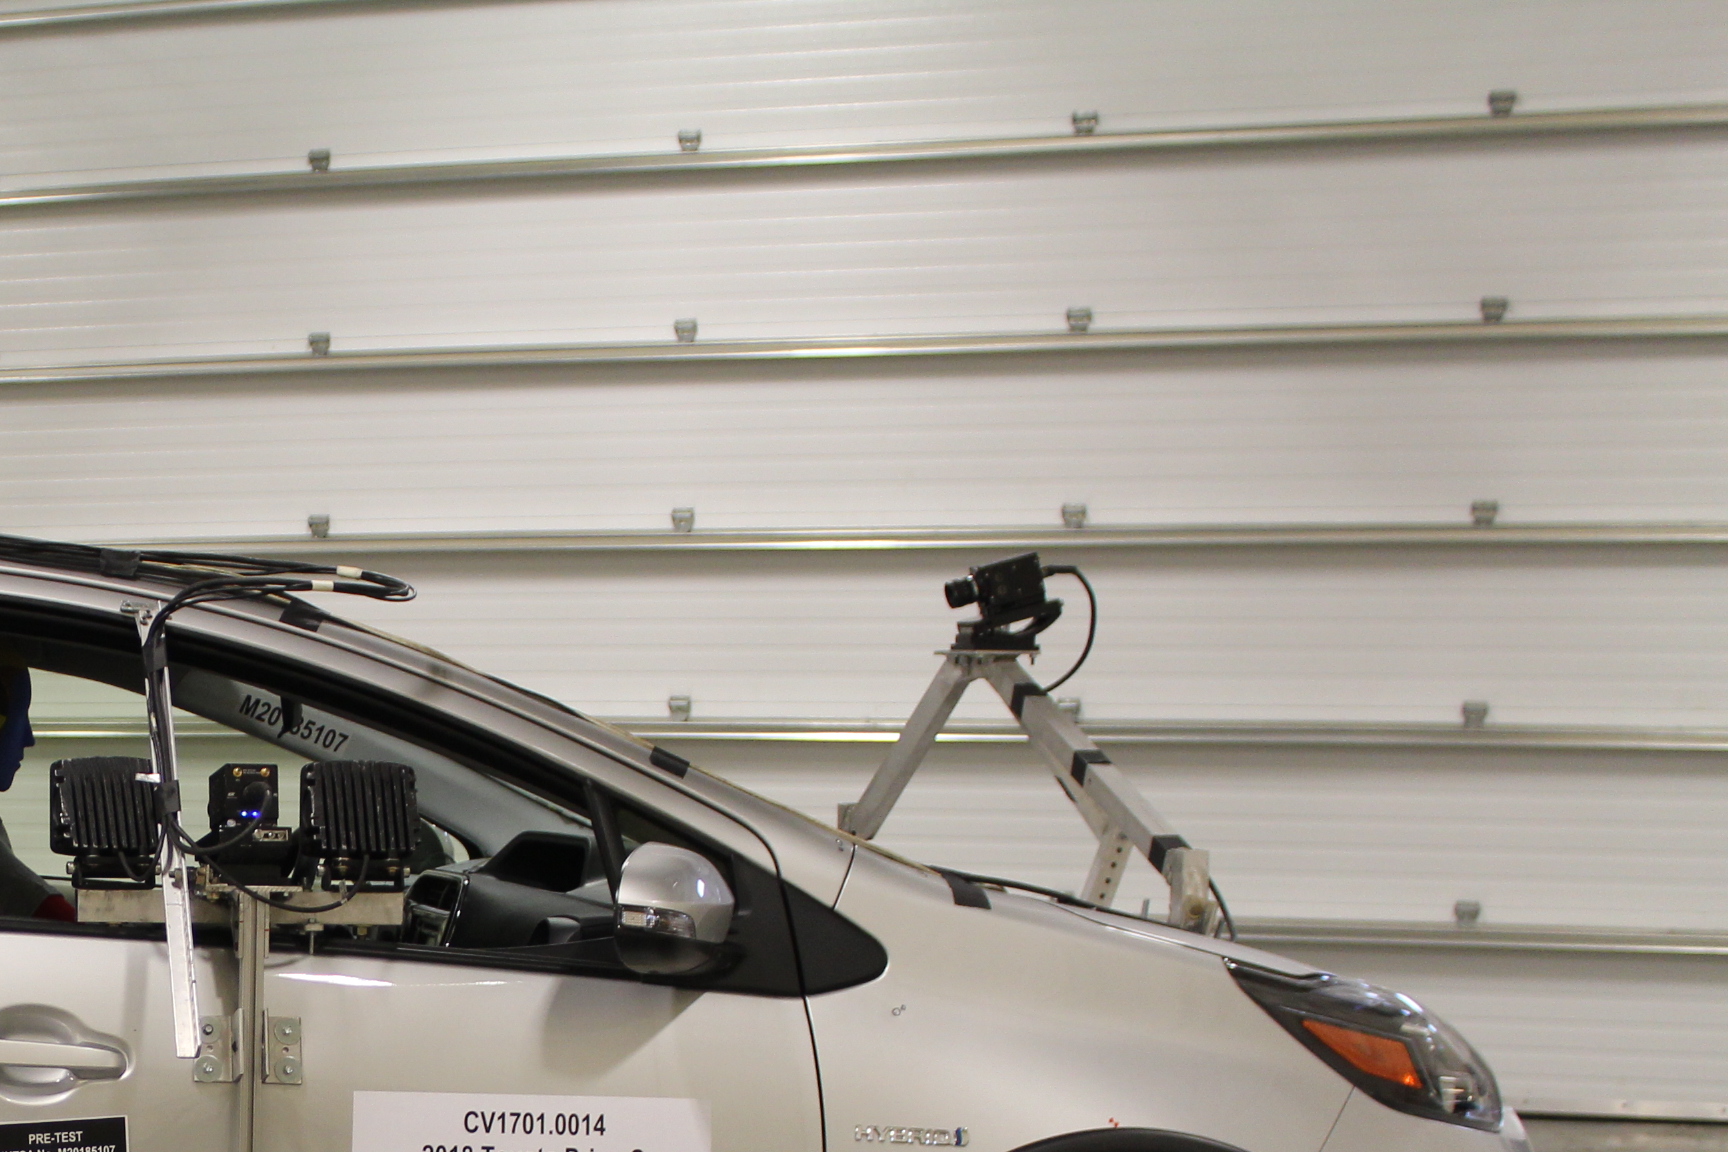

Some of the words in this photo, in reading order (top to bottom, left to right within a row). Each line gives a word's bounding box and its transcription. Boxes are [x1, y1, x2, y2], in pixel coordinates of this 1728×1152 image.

[463, 1110, 607, 1137] CV1701.0014
[28, 1130, 83, 1145] PRE-TEST
[854, 1124, 952, 1146] HYBRID
